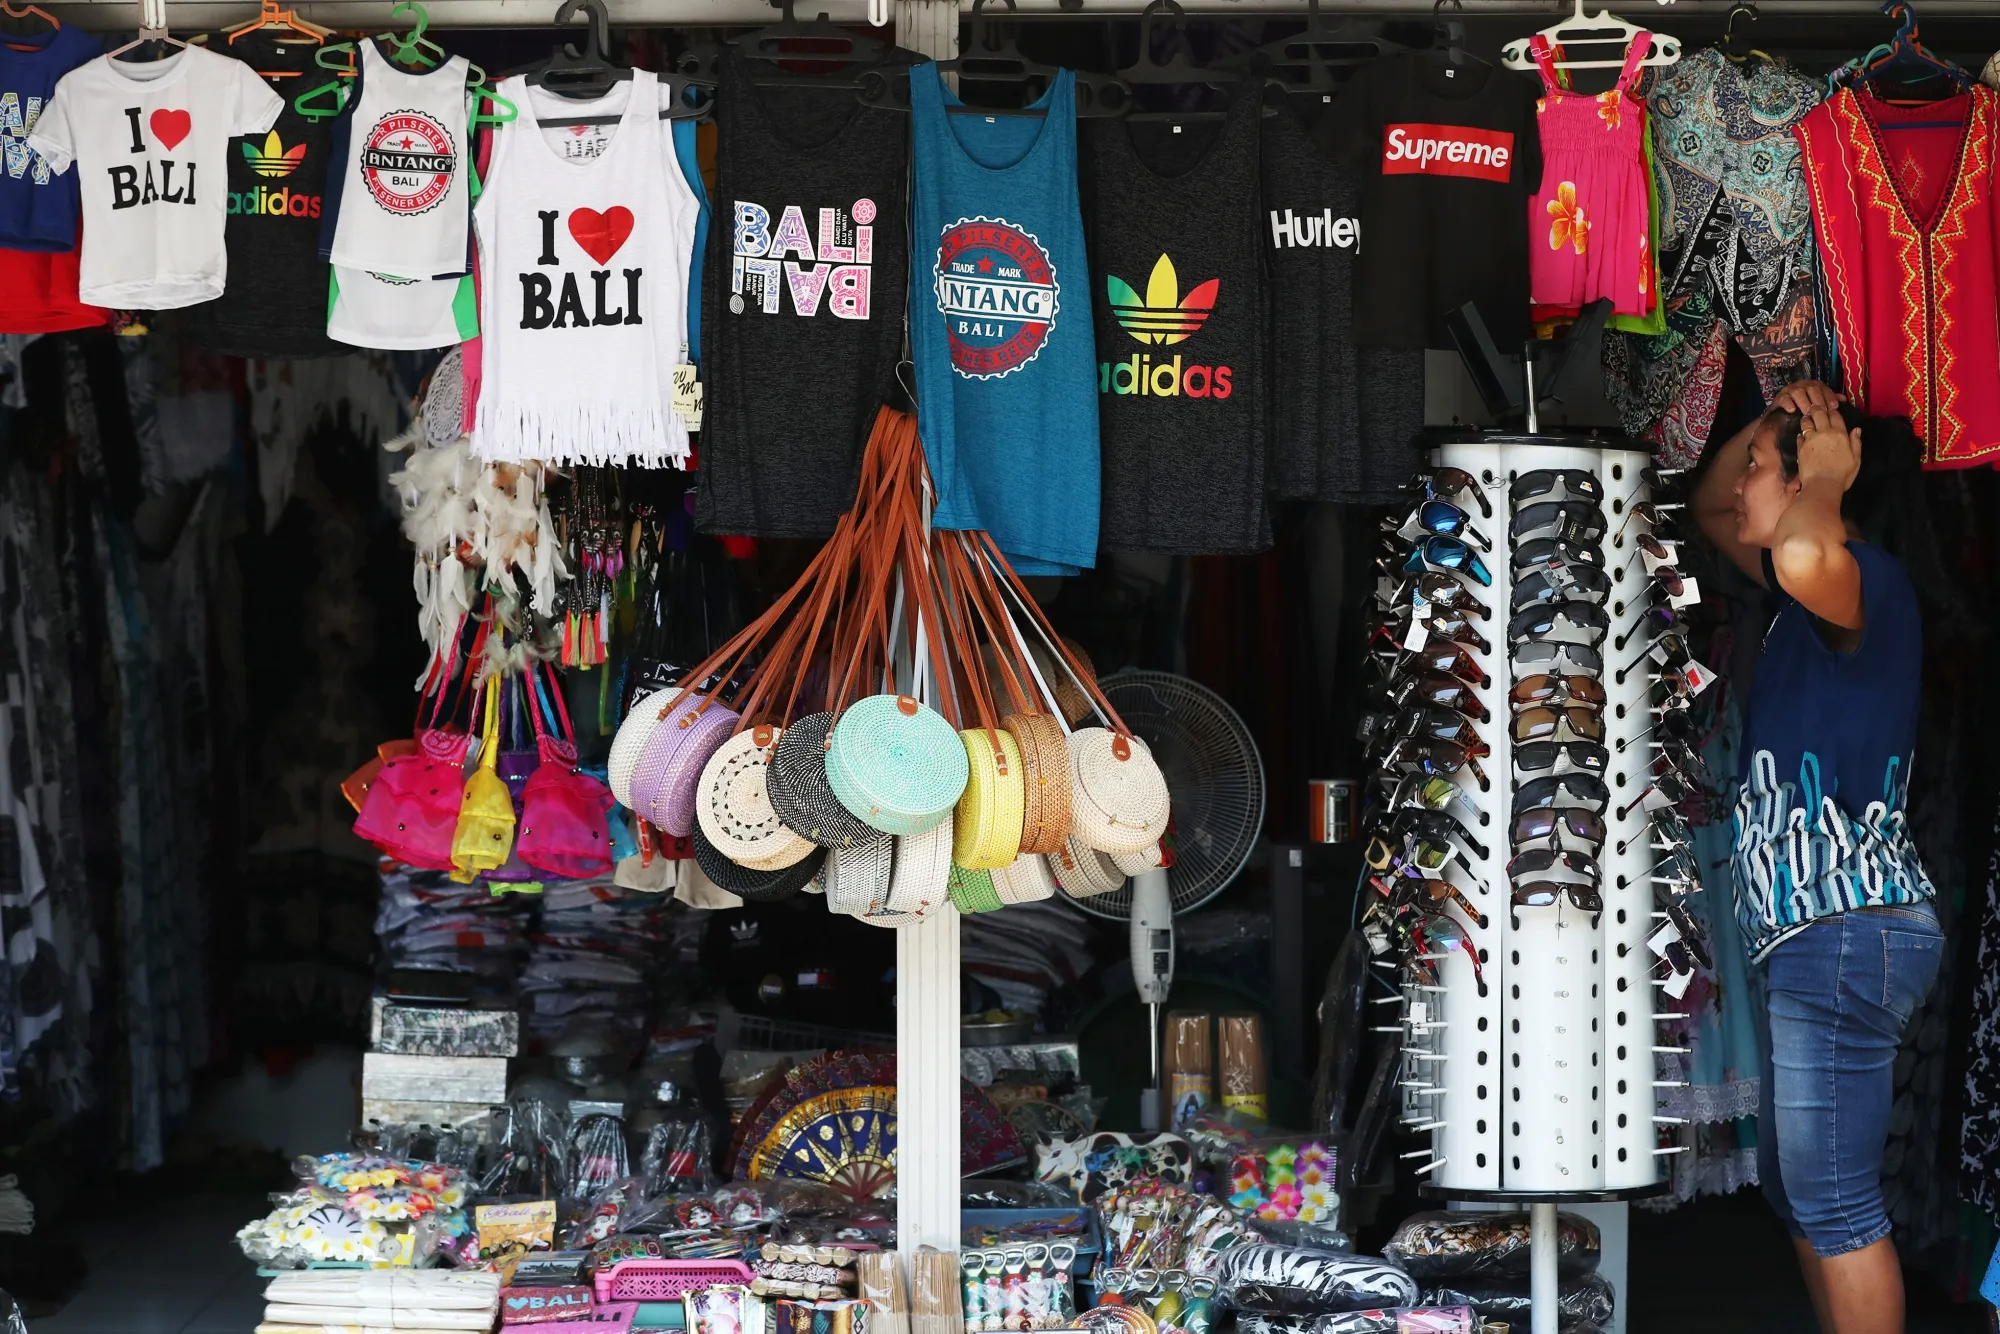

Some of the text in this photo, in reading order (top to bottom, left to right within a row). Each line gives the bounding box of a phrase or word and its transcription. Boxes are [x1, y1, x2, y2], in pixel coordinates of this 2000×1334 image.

[124, 106, 146, 153] I
[388, 119, 445, 152] PILSENER
[1385, 128, 1510, 170] Supreme
[107, 159, 196, 210] BALI
[392, 175, 419, 187] BALI
[416, 182, 443, 206] BEER
[226, 185, 321, 219] adidas
[537, 210, 560, 266] I
[1270, 208, 1361, 255] Hurley
[951, 261, 1022, 279] TRADE MARK
[518, 267, 643, 330] BALI
[944, 282, 1040, 315] NTANG
[958, 321, 1004, 338] BALI
[529, 1294, 589, 1309] BALI
